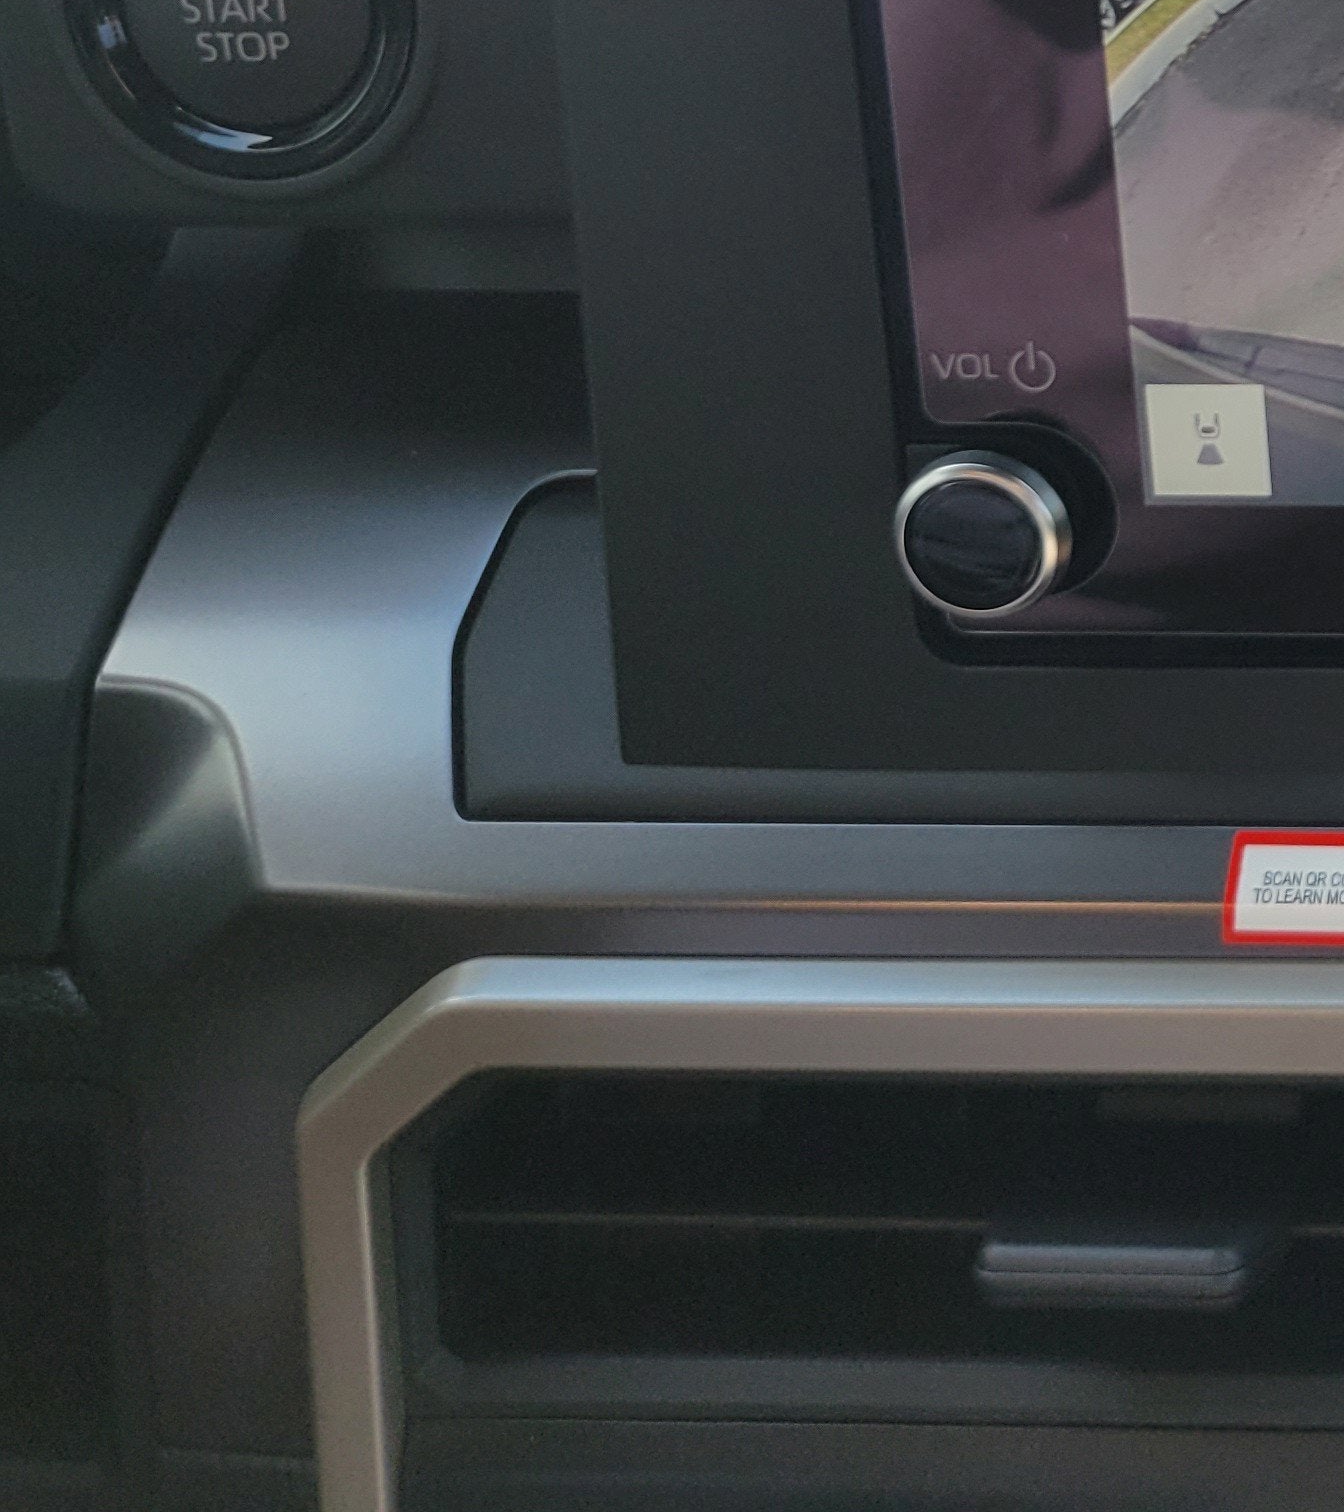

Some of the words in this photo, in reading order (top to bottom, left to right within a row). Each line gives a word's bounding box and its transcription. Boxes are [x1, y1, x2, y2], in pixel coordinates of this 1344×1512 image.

[196, 31, 290, 62] STOP
[930, 353, 999, 379] VOL
[1263, 870, 1302, 886] SCAN
[1306, 871, 1327, 887] QR
[1253, 887, 1273, 904] TO
[1275, 888, 1323, 904] LEARN
